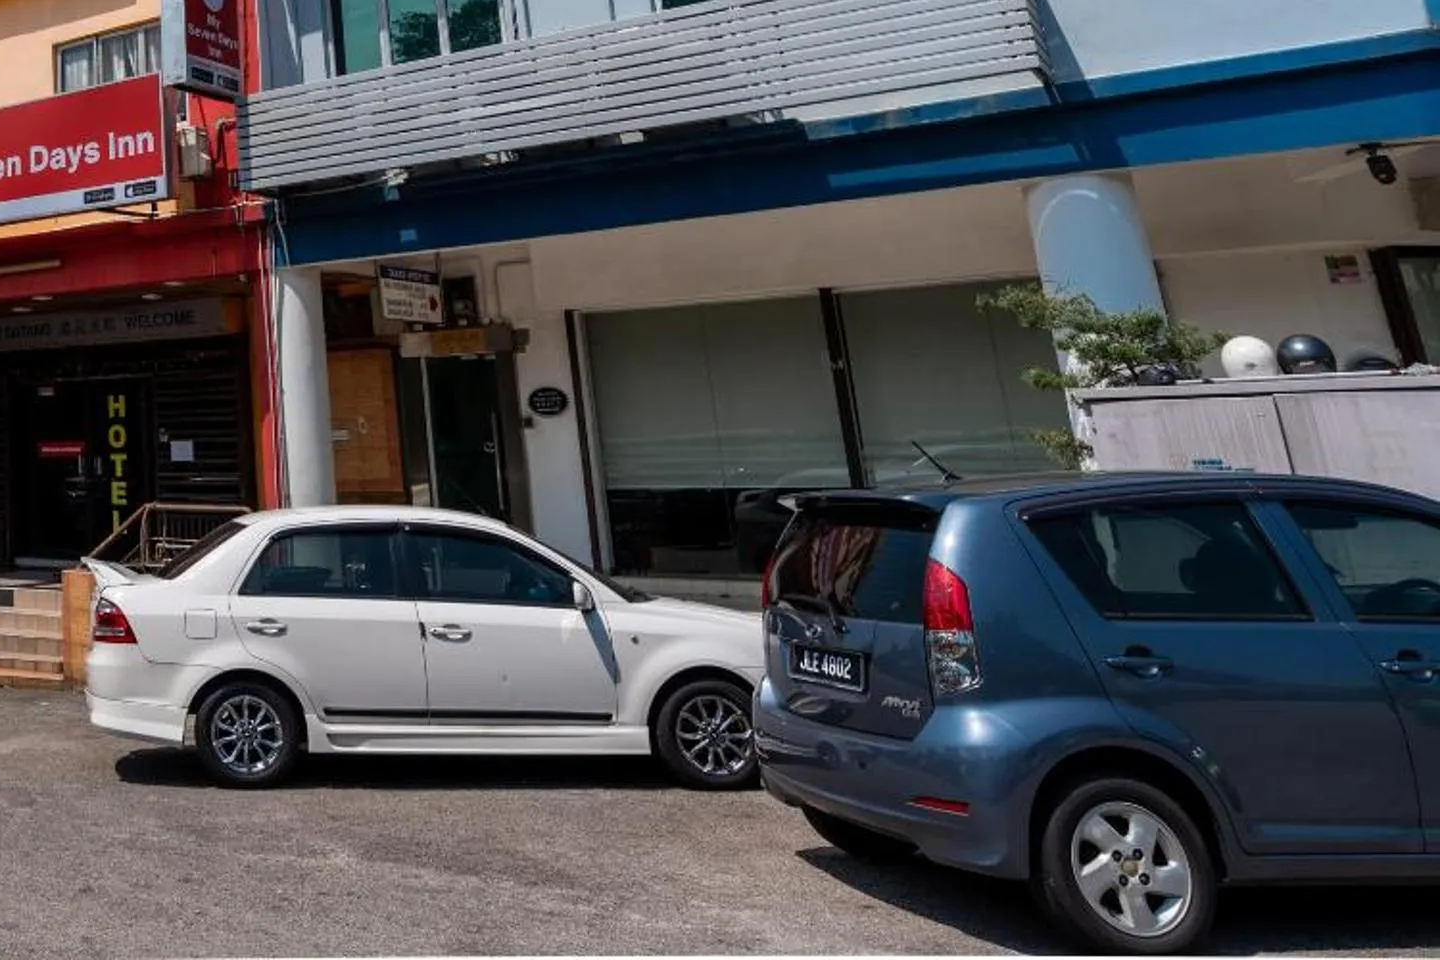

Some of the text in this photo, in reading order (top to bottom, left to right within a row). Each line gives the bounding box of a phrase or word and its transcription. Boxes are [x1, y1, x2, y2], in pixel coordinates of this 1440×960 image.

[29, 138, 101, 174] Days
[108, 129, 155, 161] Inn
[123, 309, 196, 331] WELCOME
[107, 394, 128, 535] HOTEL
[800, 650, 820, 673] JLE
